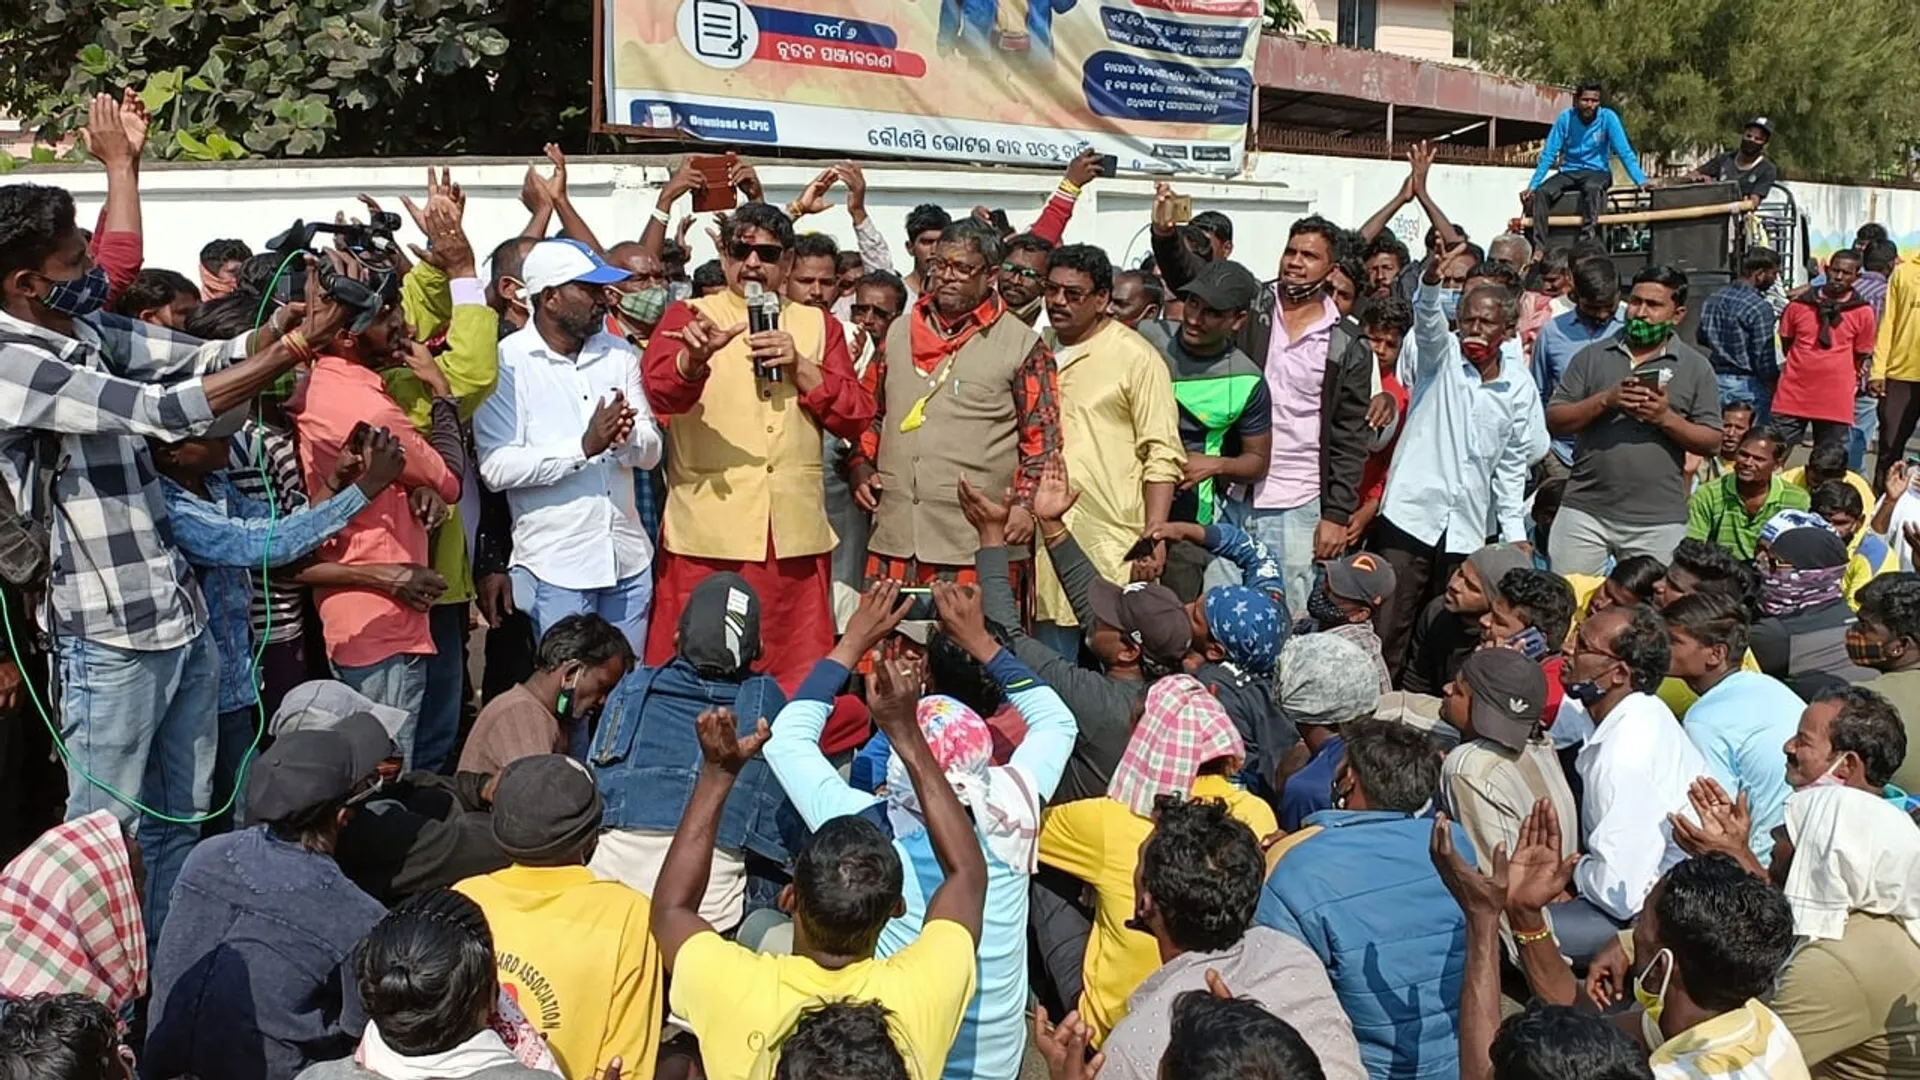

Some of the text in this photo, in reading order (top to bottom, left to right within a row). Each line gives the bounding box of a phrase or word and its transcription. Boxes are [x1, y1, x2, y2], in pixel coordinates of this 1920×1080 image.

[814, 20, 846, 38] ଫର୍ମ
[776, 41, 893, 68] ନୂତନ ପଞ୍ଜୀକରଣ
[689, 115, 739, 130] Download
[867, 126, 927, 150] କୌଣସି
[932, 134, 991, 154] ଭୋଟର
[496, 950, 562, 1030] ARD ASSOCIATION
